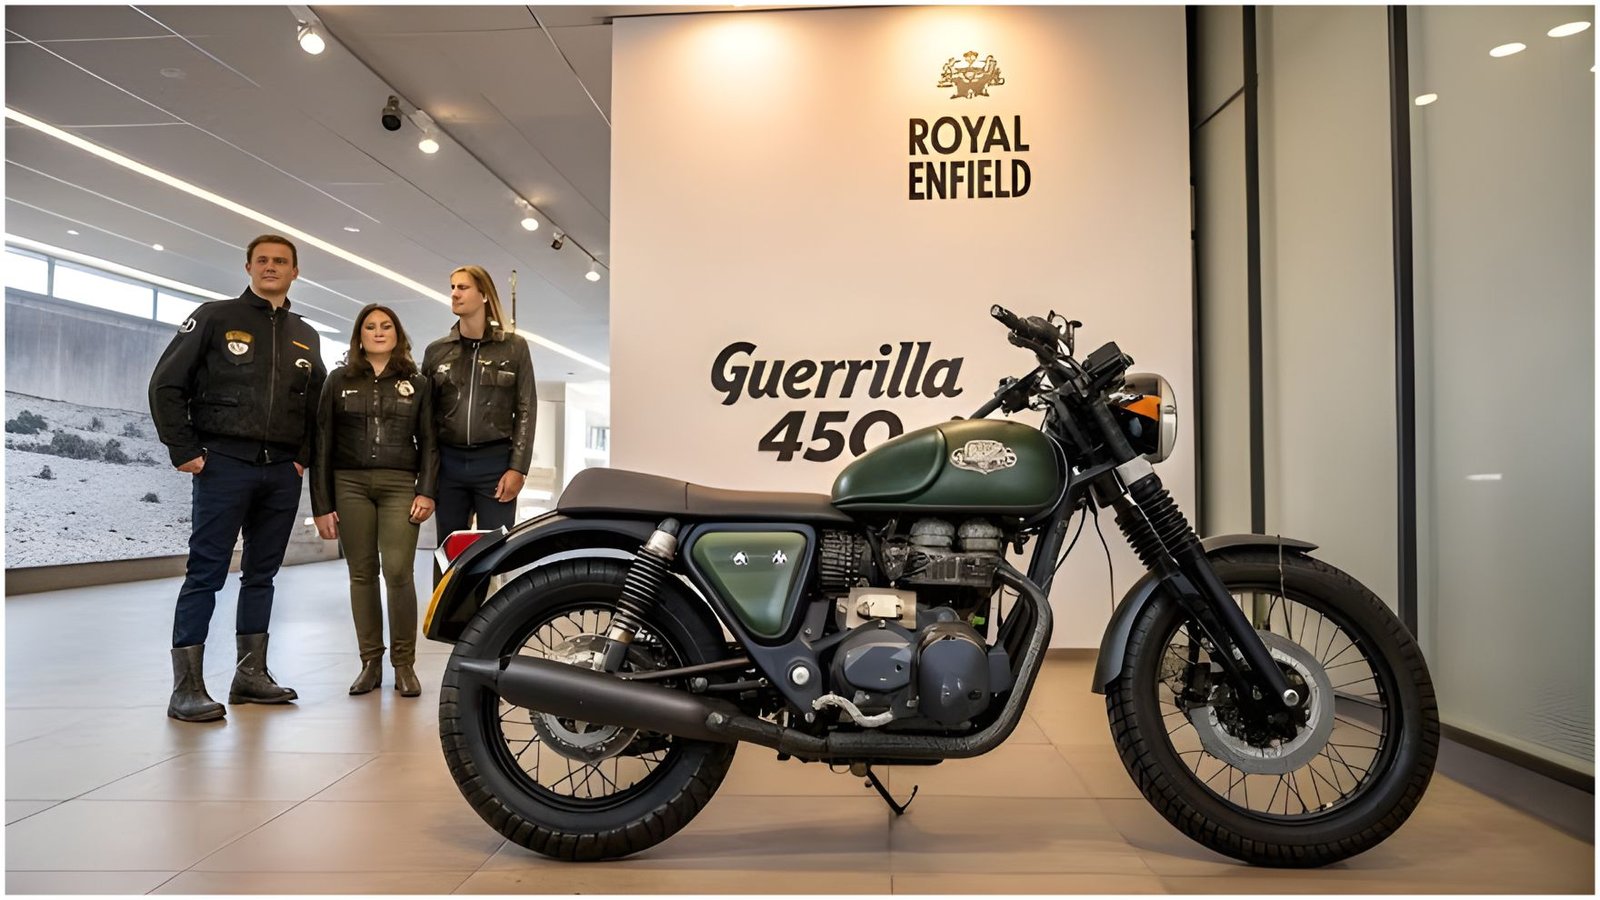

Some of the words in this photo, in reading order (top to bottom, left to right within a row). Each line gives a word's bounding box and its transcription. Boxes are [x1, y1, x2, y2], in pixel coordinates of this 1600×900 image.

[909, 115, 1030, 155] ROYAL
[908, 159, 1032, 200] ENFIELD
[710, 341, 964, 406] Guerrilla
[757, 409, 904, 463] 450
